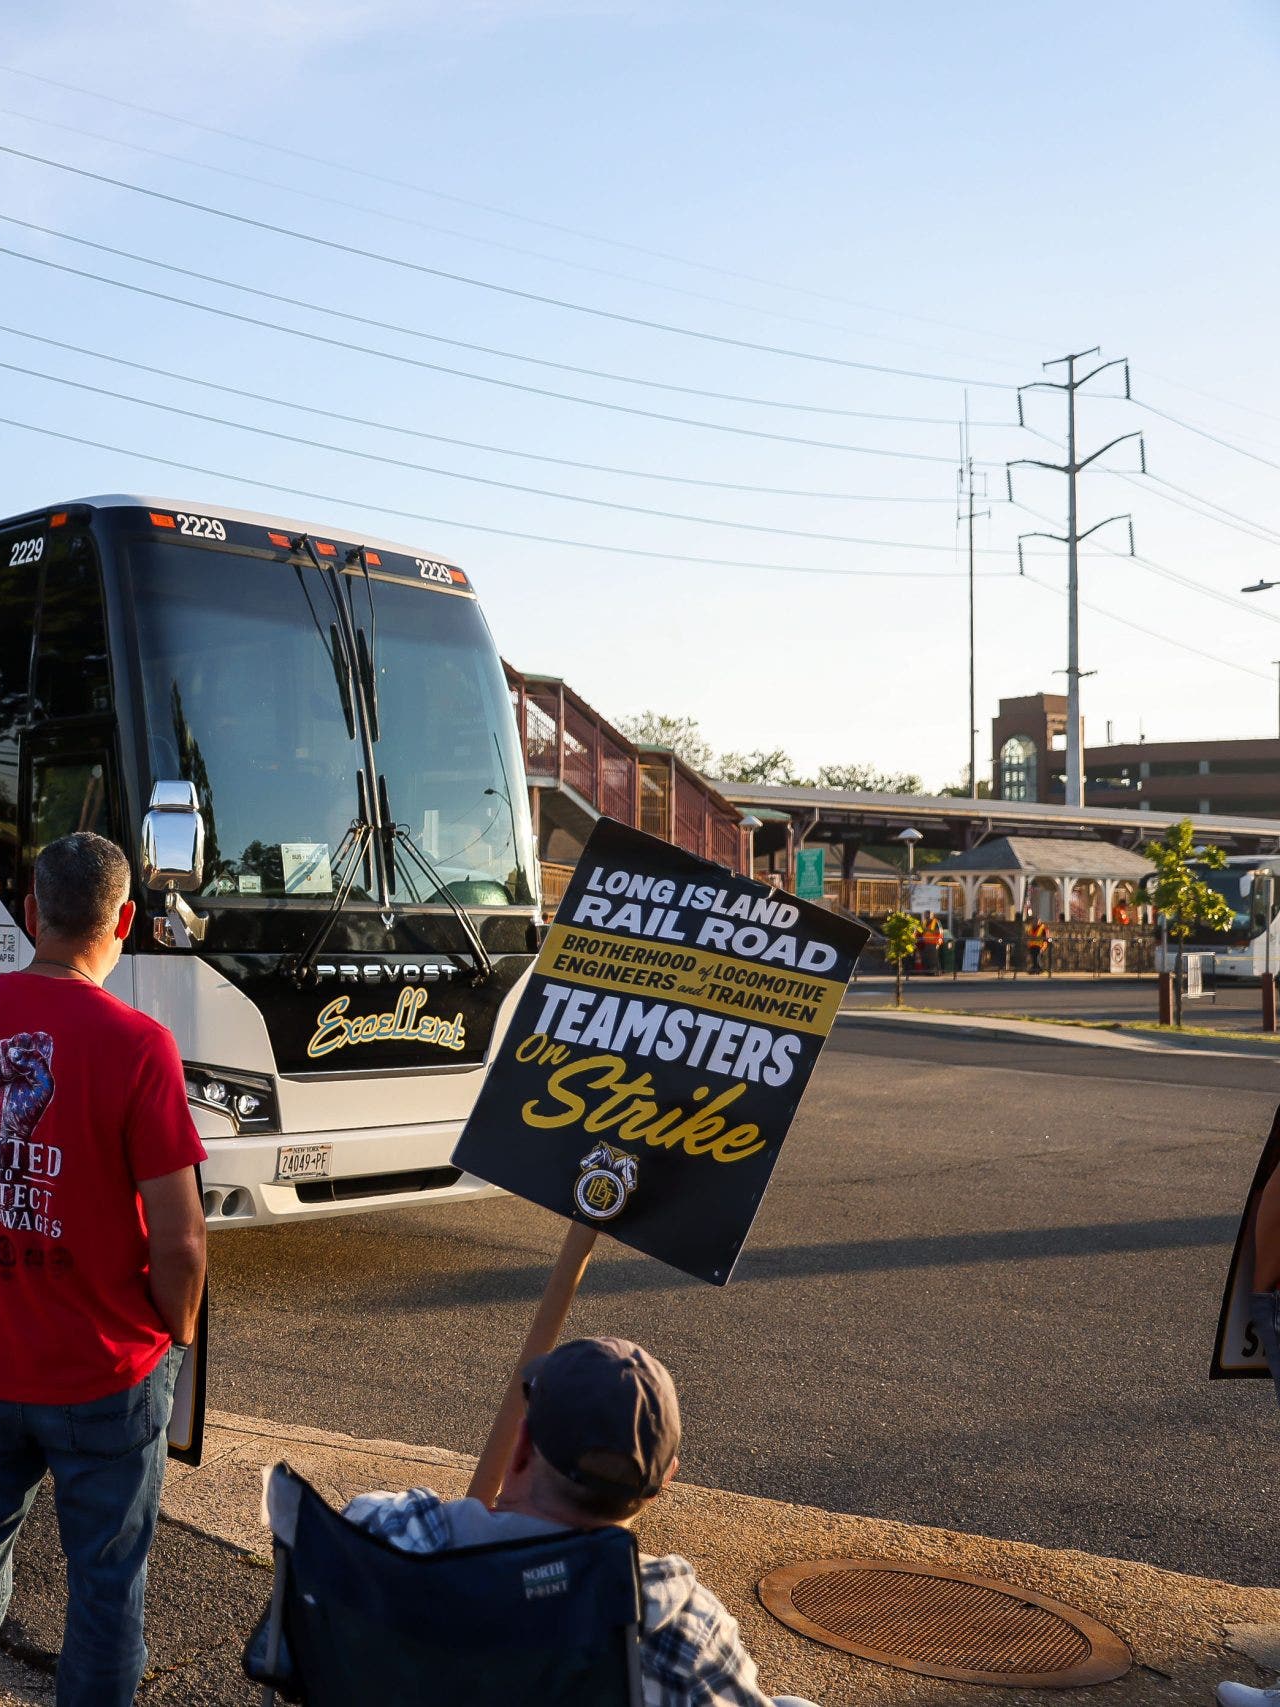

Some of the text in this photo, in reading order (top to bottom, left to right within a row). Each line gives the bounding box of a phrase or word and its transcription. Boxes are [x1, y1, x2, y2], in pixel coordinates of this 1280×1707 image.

[8, 537, 44, 567] 2229
[177, 514, 226, 541] 2229
[415, 558, 453, 585] 2229
[586, 866, 800, 929] LONG ISLAND
[571, 896, 838, 973] RAIL ROAD
[316, 964, 459, 983] PREVOST
[552, 953, 818, 1024] ENGINEERS and TRAINMEN
[561, 933, 828, 1003] BROTHERHOOD of LOCOMOTIVE
[307, 986, 466, 1058] Excellent
[532, 983, 801, 1088] TEAMSTERS
[515, 1032, 768, 1164] On Strike
[0, 1210, 63, 1239] WAGES
